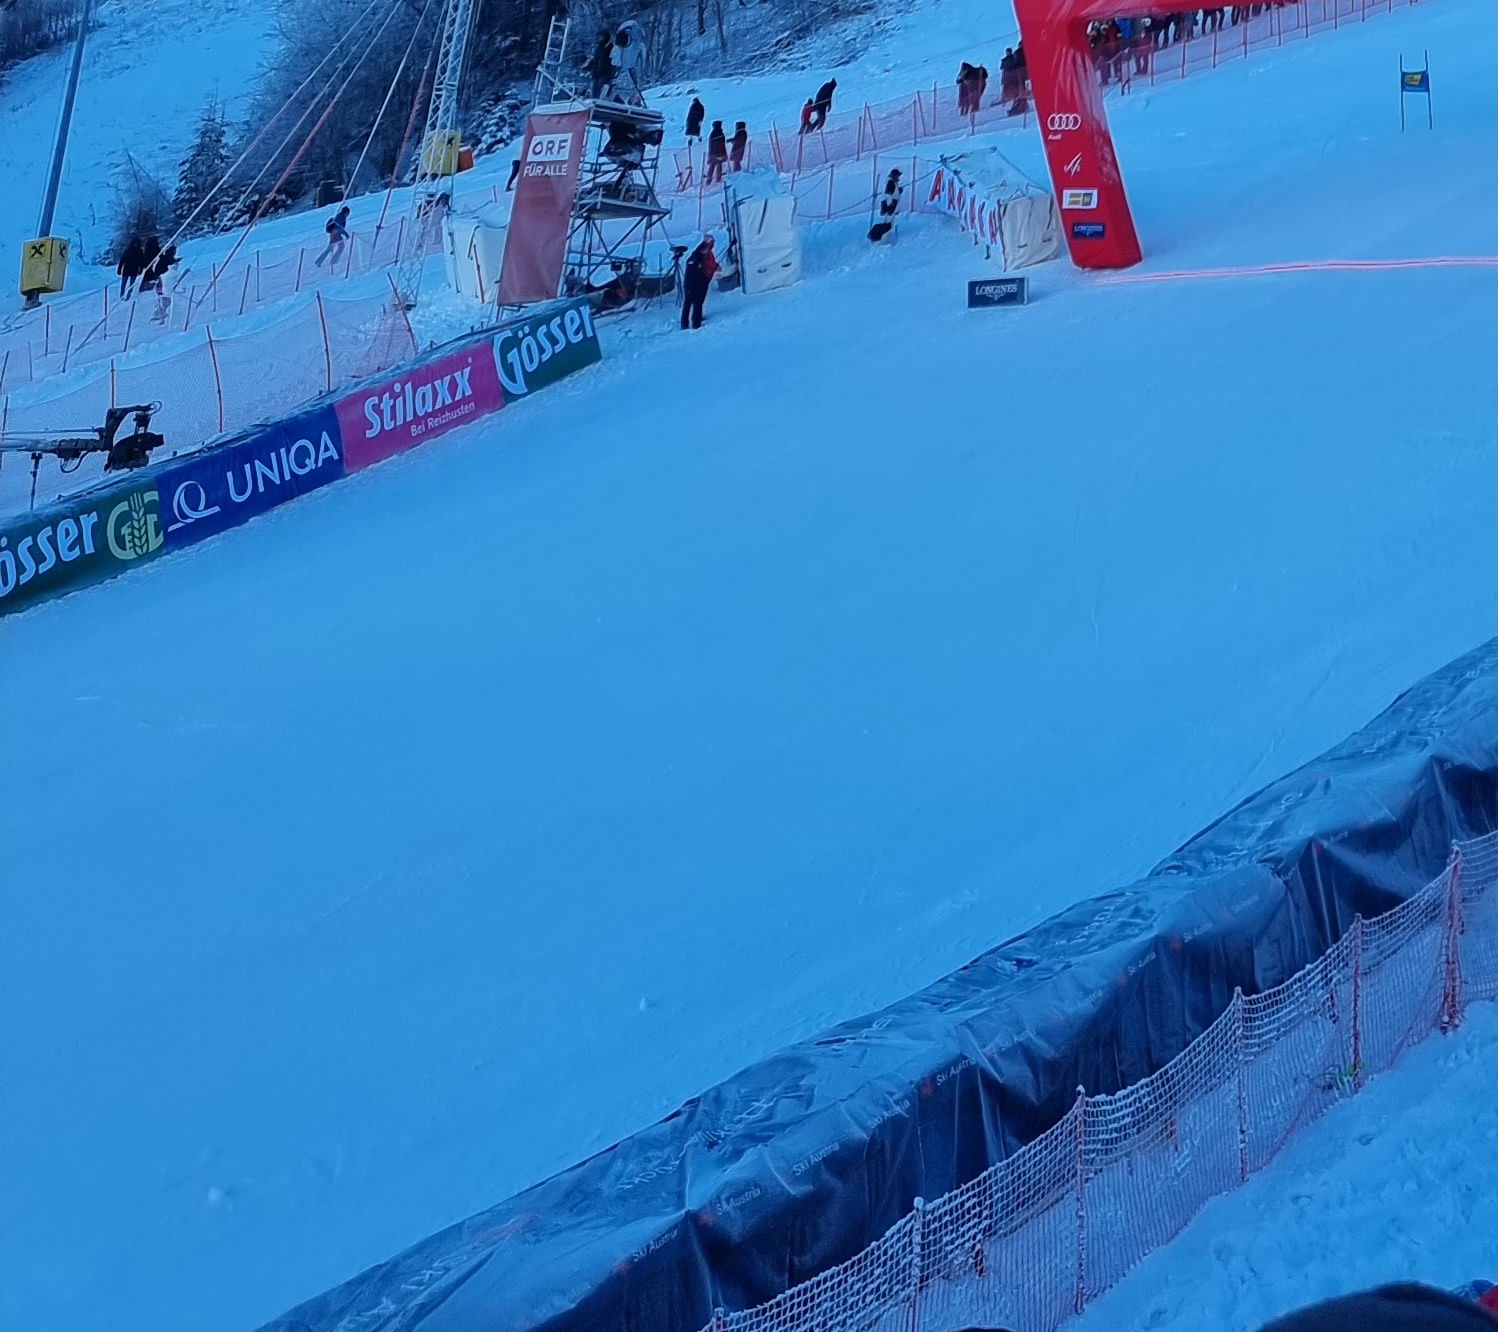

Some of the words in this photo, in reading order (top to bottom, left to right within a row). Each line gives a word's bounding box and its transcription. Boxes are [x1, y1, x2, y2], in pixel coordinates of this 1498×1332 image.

[523, 163, 543, 177] FÜR
[543, 163, 568, 176] ALLE
[532, 139, 568, 156] ORF
[975, 284, 1018, 297] LONGINES
[493, 304, 593, 395] Gösser
[364, 365, 473, 438] Stilaxx
[410, 423, 426, 437] Bei
[427, 401, 475, 428] Reizhusten
[226, 430, 340, 504] UNIQA
[0, 510, 98, 597] össer
